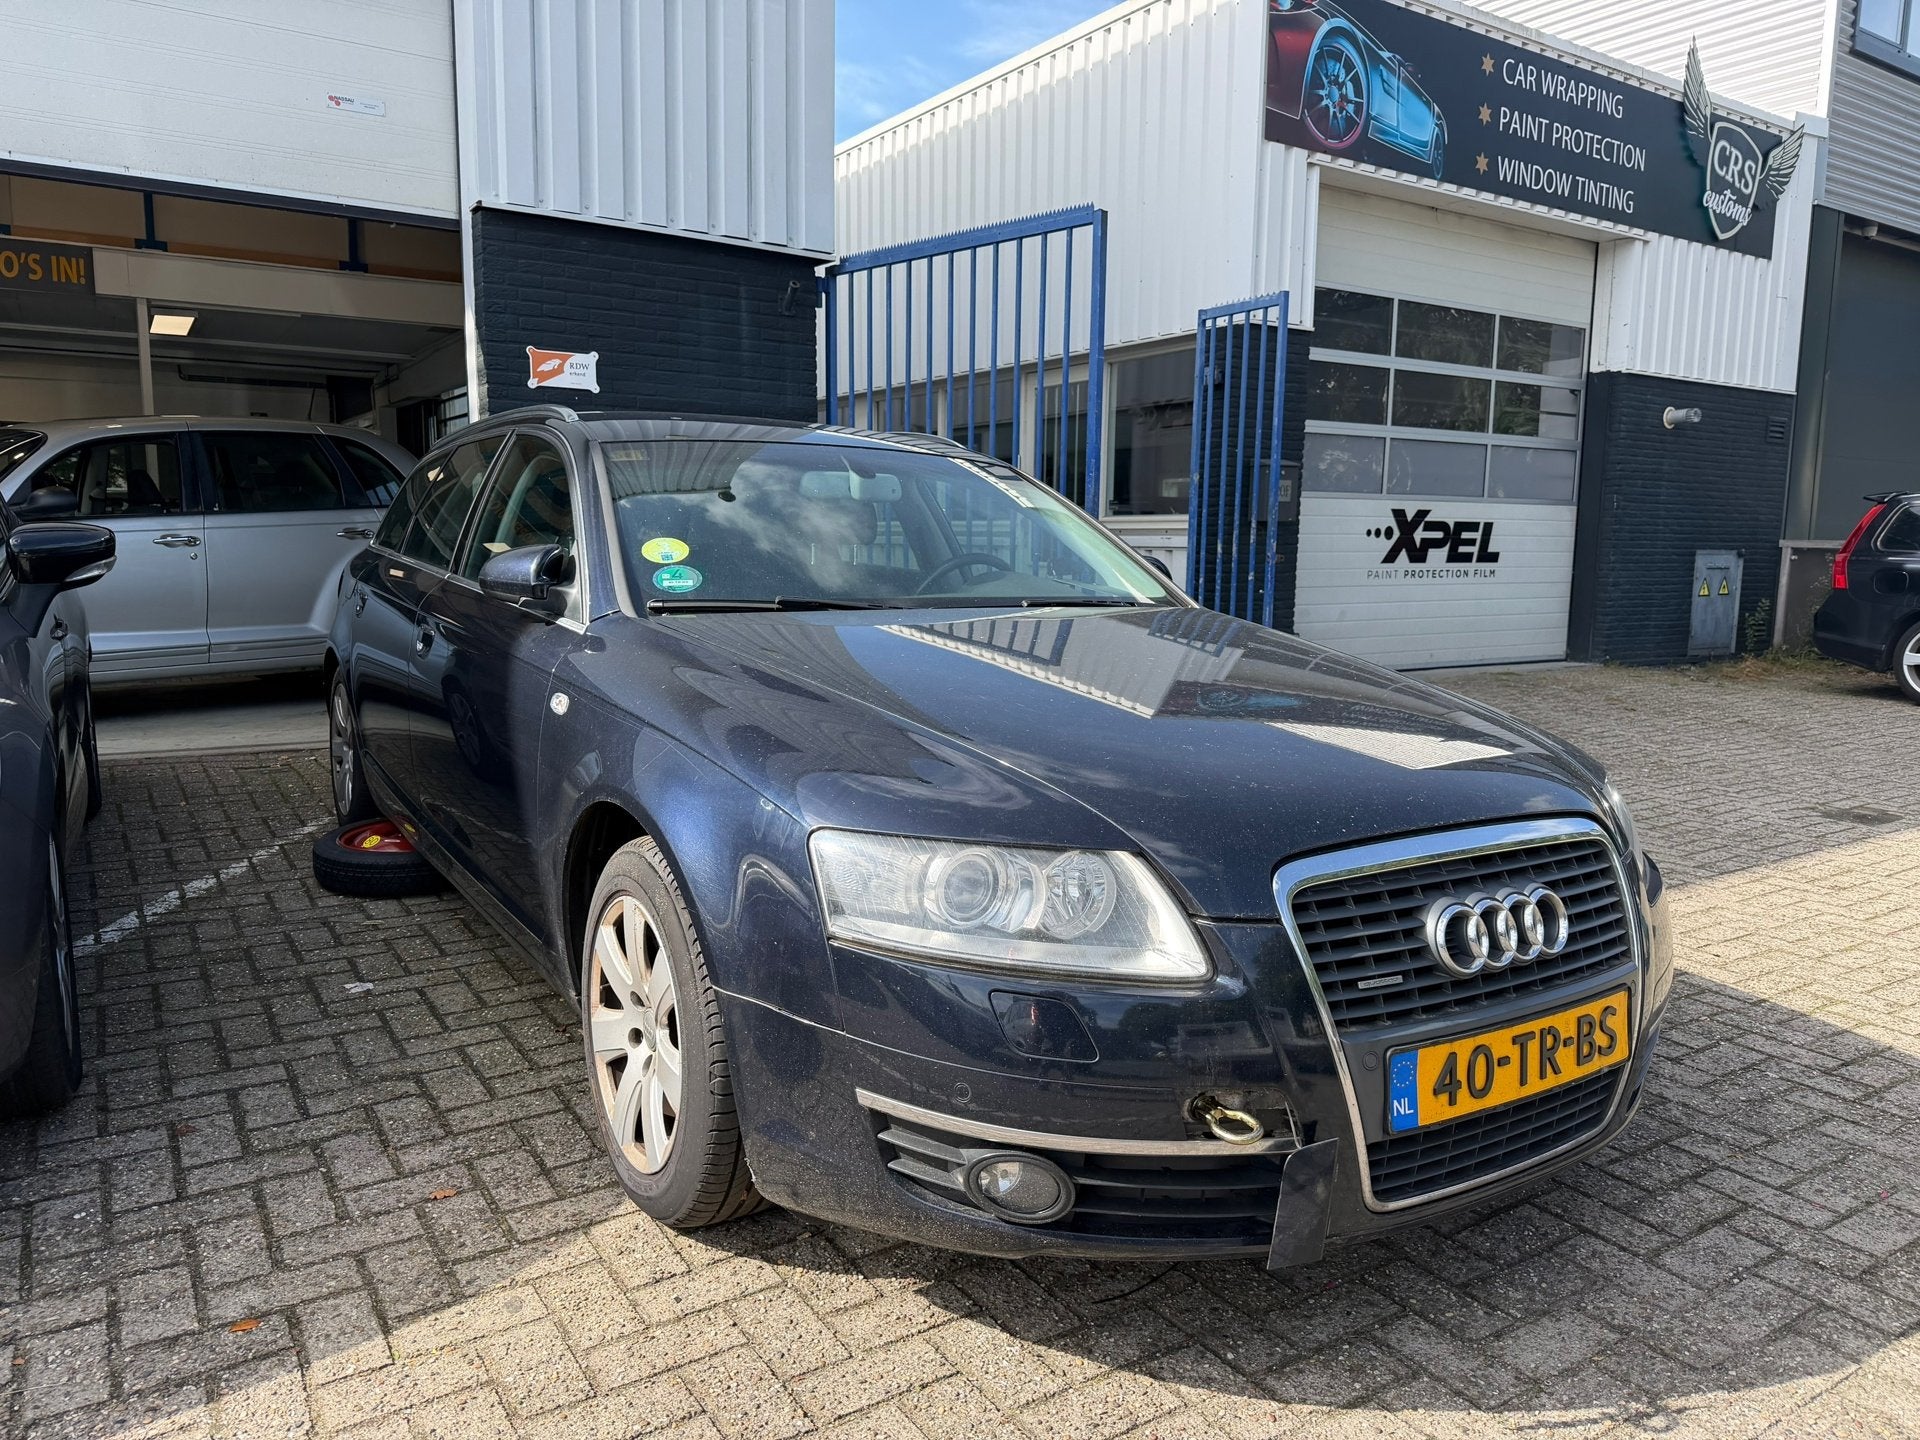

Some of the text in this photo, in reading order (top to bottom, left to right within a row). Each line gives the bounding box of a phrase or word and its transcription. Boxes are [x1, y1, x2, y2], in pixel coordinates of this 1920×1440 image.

[334, 95, 355, 103] NASSAU
[1502, 58, 1623, 119] CAR WRAPPING
[1499, 107, 1646, 172] PAINT PROTECTION
[1497, 156, 1634, 214] WINDOW TINTING
[1713, 139, 1756, 195] CRS
[1702, 188, 1753, 226] customs
[50, 255, 87, 285] IN!
[569, 362, 590, 370] RDW
[1380, 508, 1501, 564] XPEL
[671, 568, 684, 580] 4
[1366, 568, 1496, 580] PAINT PROTECTION FILM
[1432, 1005, 1618, 1107] 40-TR-BS
[1393, 1099, 1414, 1117] NL
